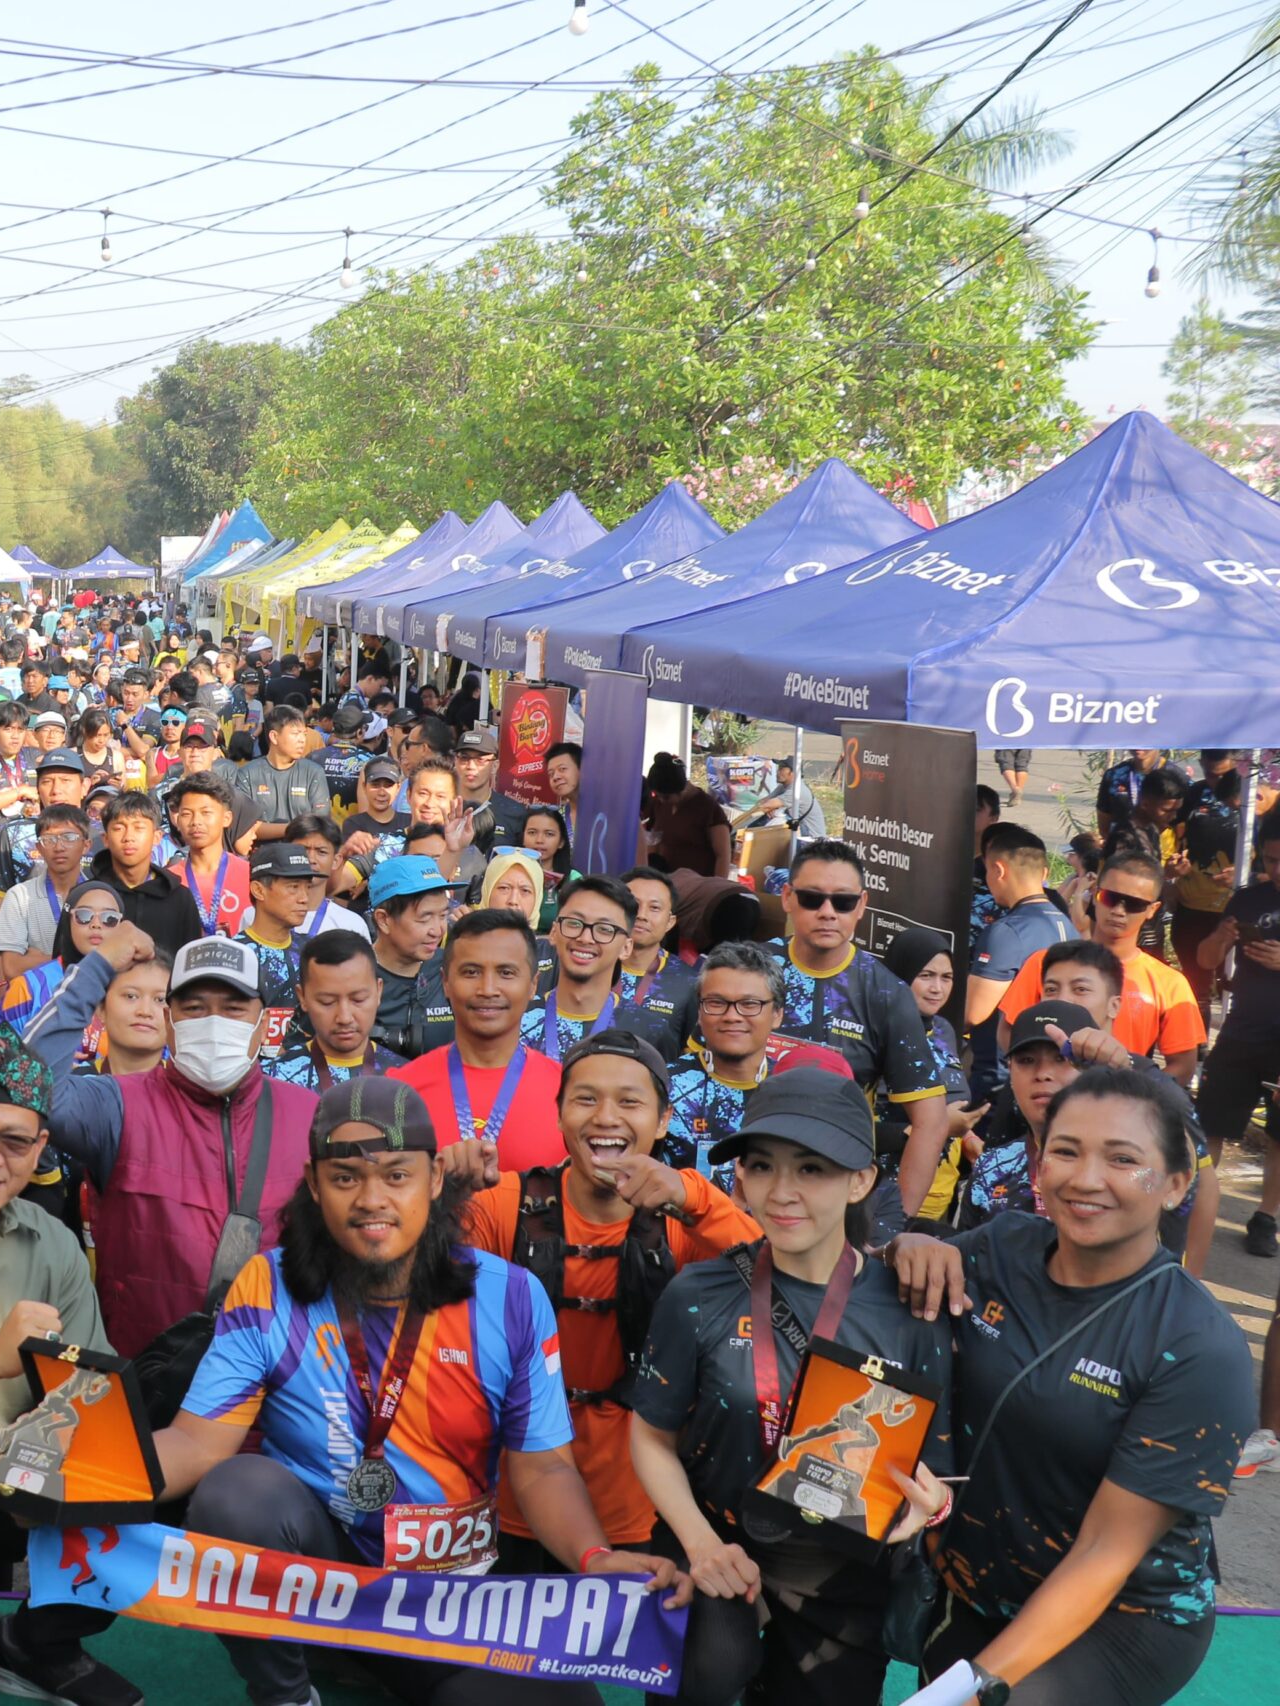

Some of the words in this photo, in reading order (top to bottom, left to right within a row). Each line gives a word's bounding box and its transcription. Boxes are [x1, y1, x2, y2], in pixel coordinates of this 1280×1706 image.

[901, 551, 1018, 596] Biznet
[502, 636, 517, 654] Biznet
[564, 646, 602, 669] #PakeBiznet
[656, 657, 682, 682] Biznet
[784, 672, 870, 712] #PakeBiznet
[1048, 693, 1160, 725] Biznet
[519, 719, 546, 732] Bintang
[517, 761, 544, 774] EXPRESS
[863, 750, 889, 768] Biznet
[863, 770, 885, 783] Home
[843, 810, 900, 840] Bandwidth
[902, 823, 933, 849] Besar
[870, 845, 910, 871] Semua
[650, 999, 674, 1009] KOPO
[267, 1017, 288, 1037] 50
[831, 1027, 863, 1041] RUNNERS
[832, 1017, 864, 1034] KOPO
[1075, 1357, 1122, 1386] KOPO
[1069, 1372, 1120, 1399] RUNNERS
[808, 1463, 833, 1477] KOPO
[395, 1514, 492, 1562] 5025
[157, 1534, 358, 1621] BALAD
[382, 1575, 652, 1659] LUMPAT
[489, 1648, 535, 1673] GARUT
[538, 1656, 671, 1687] #Lumpatkeun
